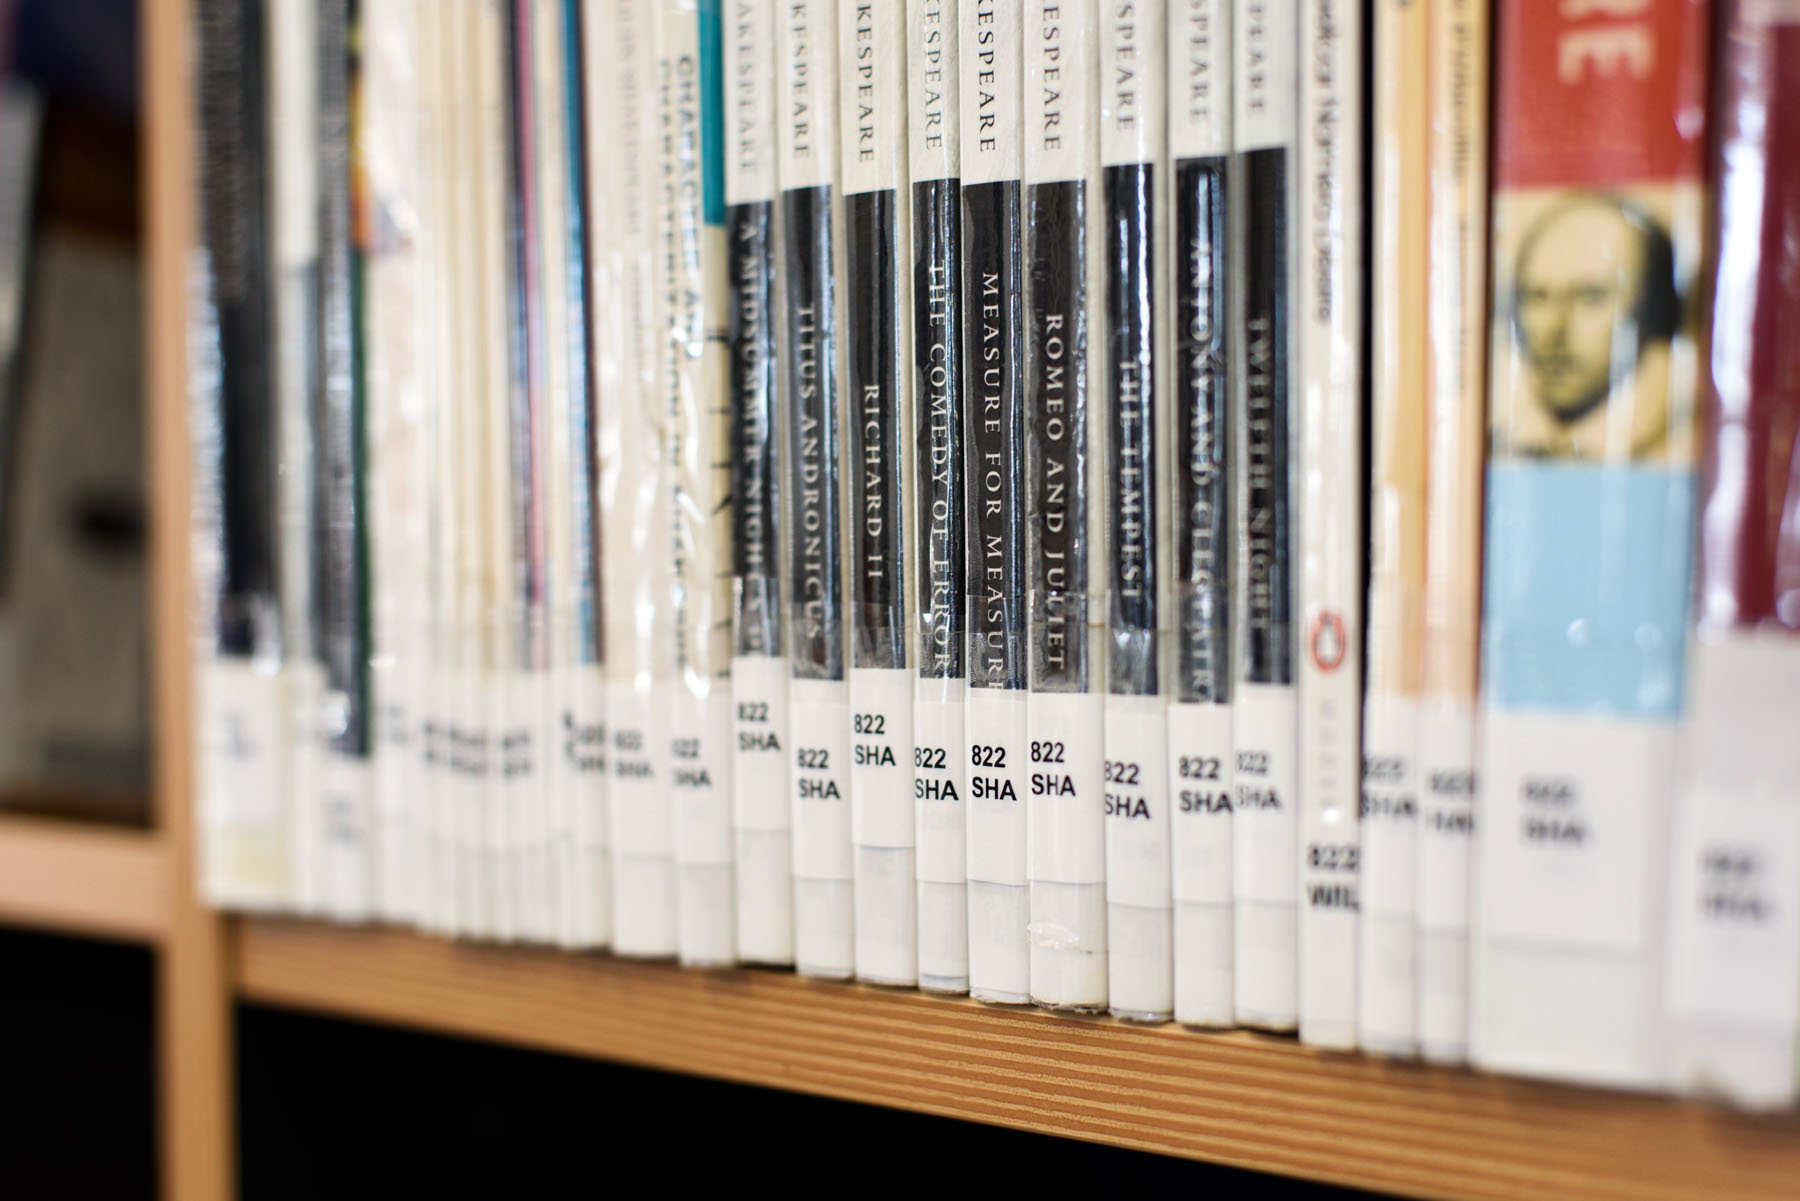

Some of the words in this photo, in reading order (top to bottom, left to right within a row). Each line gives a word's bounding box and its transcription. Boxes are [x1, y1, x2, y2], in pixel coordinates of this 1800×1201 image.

[791, 3, 811, 160] KESPEARE
[856, 4, 875, 163] KESPEARE
[924, 0, 943, 150] ESPEARE
[1115, 4, 1136, 132] SPEARE
[929, 260, 945, 327] THE
[798, 303, 817, 399] TITUS
[983, 271, 1000, 434] MEASURE
[1045, 313, 1065, 441] ROMEO
[1119, 352, 1140, 427] THE
[930, 343, 949, 486] COMEDY
[864, 385, 883, 538] RICHARD
[985, 453, 1002, 518] FOR
[1046, 458, 1065, 534] AND
[800, 413, 825, 640] ANDRONICUS
[932, 499, 950, 541] OF
[1120, 440, 1142, 604] TEMPEST
[867, 554, 883, 578] II
[1045, 551, 1065, 671] JULIET
[737, 702, 768, 722] 822
[854, 714, 885, 735] 822
[737, 732, 781, 752] SHA
[797, 749, 829, 769] 822
[855, 745, 896, 767] SHA
[915, 748, 946, 769] 822
[971, 745, 1006, 768] 822
[1030, 741, 1065, 764] 822
[1031, 773, 1076, 797] SHA
[1105, 760, 1139, 786] 822
[1179, 756, 1221, 781] 822
[798, 779, 841, 800] SHA
[915, 778, 959, 801] SHA
[971, 776, 1017, 801] SHA
[1179, 790, 1234, 814] SHA
[1105, 793, 1151, 820] SHA
